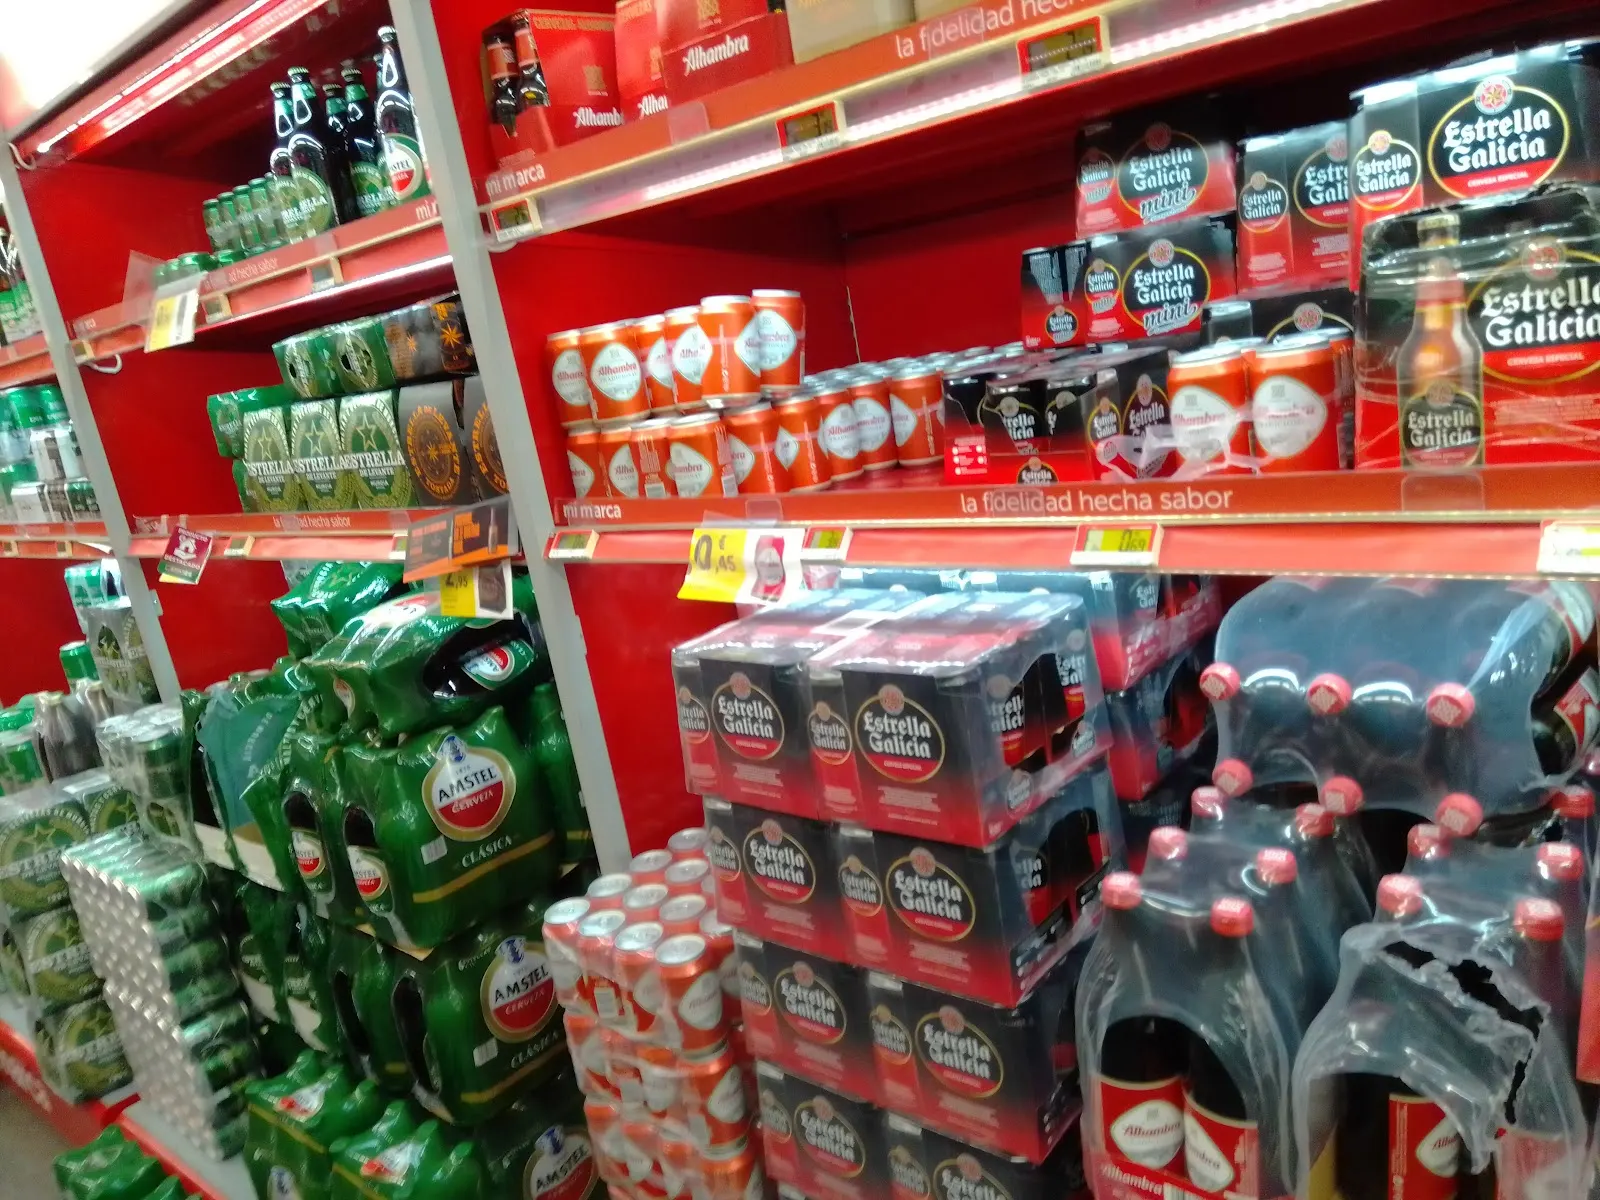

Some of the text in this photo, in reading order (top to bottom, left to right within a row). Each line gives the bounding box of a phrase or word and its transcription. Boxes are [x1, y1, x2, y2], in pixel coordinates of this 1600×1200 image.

[895, 34, 915, 60] la
[919, 1, 1015, 49] fidelidad
[683, 33, 750, 77] Alhambra
[1443, 106, 1552, 149] Estrella
[1129, 146, 1193, 174] Estrella
[1355, 152, 1413, 177] Estrella
[1448, 134, 1546, 173] Galicia
[486, 163, 546, 195] mi marca
[1081, 169, 1110, 184] Galicia
[1133, 164, 1192, 191] Galicia
[1358, 169, 1410, 193] Galicia
[1140, 181, 1197, 220] mini
[1241, 189, 1282, 210] Estrella
[1243, 201, 1281, 221] Galicia
[1087, 273, 1115, 285] Estrella
[1088, 279, 1114, 293] Galicia
[1133, 264, 1195, 288] Estrella
[1137, 280, 1193, 305] Galicia
[1048, 314, 1073, 325] Estrella
[1050, 320, 1073, 332] Galicia
[1143, 299, 1198, 336] mini
[1485, 307, 1600, 347] Galicia
[597, 361, 638, 376] Alhambra
[1093, 413, 1117, 427] Estrella
[1129, 401, 1165, 428] Estrella
[1408, 410, 1476, 438] Estrella
[1095, 424, 1117, 440] Galicia
[1410, 421, 1473, 450] Galicia
[344, 450, 406, 471] ESTRELLA
[1021, 468, 1053, 481] Estrella
[563, 503, 622, 520] mi marca
[960, 486, 1233, 514] la fidelidad hecha sabor
[718, 694, 774, 721] Estrella
[722, 714, 774, 738] Galicia
[810, 721, 846, 738] Estrella
[863, 711, 932, 738] Estrella
[812, 731, 846, 751] Galicia
[868, 733, 932, 759] Galicia
[438, 766, 498, 803] AMSTEL
[451, 789, 494, 814] CERVEZA
[462, 835, 513, 868] CLÁSICA
[750, 839, 805, 869] Estrella
[754, 857, 806, 886] Galicia
[841, 872, 878, 892] Estrella
[895, 870, 963, 902] Estrella
[900, 890, 963, 922] Galicia
[494, 963, 550, 1004] AMSTEL
[780, 977, 836, 1012] Estrella
[505, 987, 546, 1016] CERVEZA
[785, 997, 837, 1028] Galicia
[923, 1023, 991, 1062] Estrella
[928, 1040, 991, 1080] Galicia
[1124, 1119, 1181, 1137] Alhambra
[1102, 1164, 1164, 1196] Alhambra
